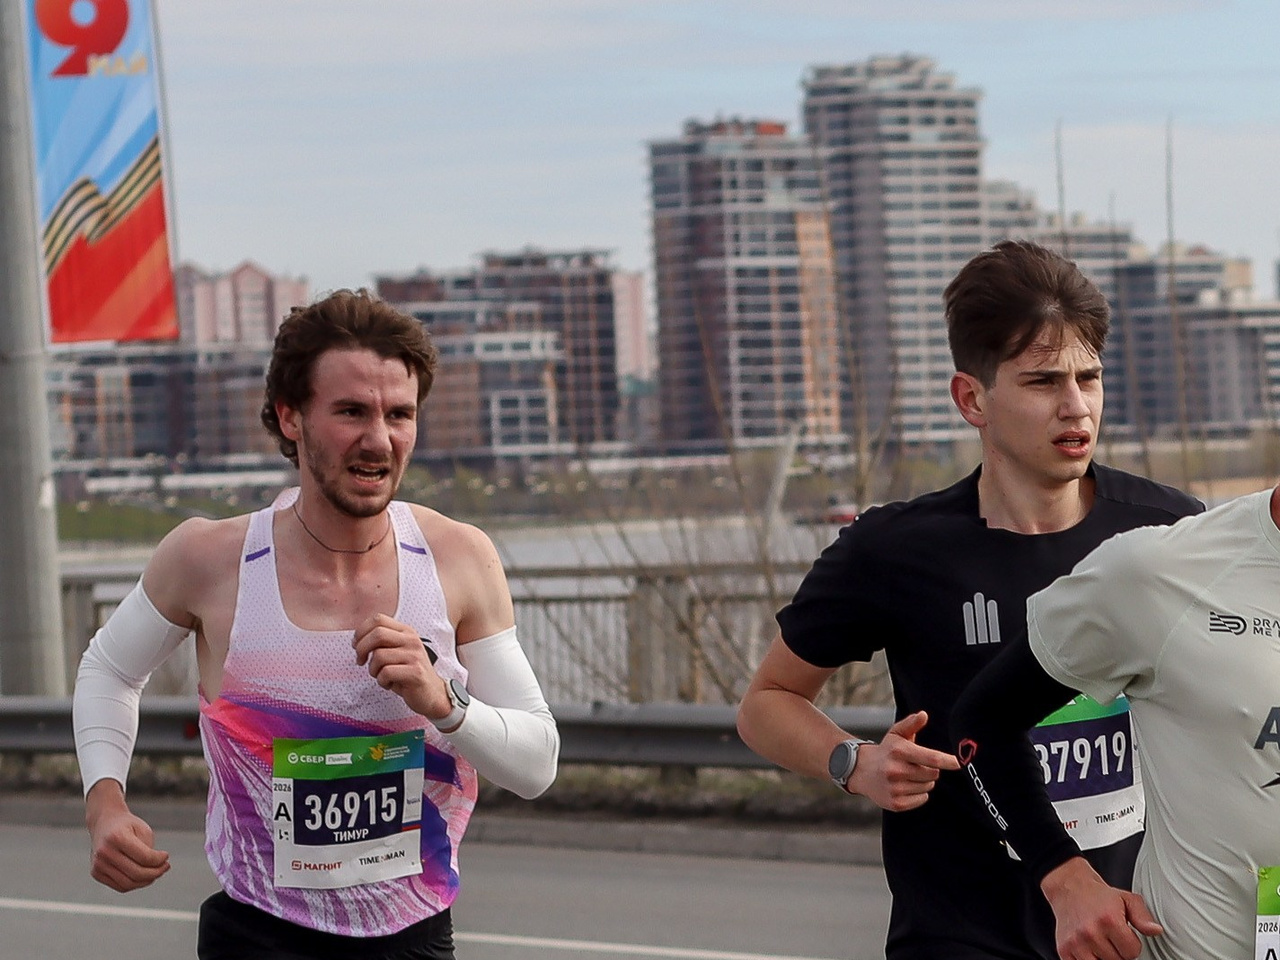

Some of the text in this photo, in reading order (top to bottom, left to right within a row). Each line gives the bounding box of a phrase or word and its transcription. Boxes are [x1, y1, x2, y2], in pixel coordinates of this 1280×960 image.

[34, 0, 129, 77] 9
[1253, 626, 1273, 637] ME
[273, 782, 292, 792] 2026
[966, 762, 1009, 832] COROS
[304, 786, 398, 831] 36915
[333, 828, 369, 842] ТИМУР
[303, 861, 342, 871] МАГНИТ
[1258, 921, 1279, 933] 2026
